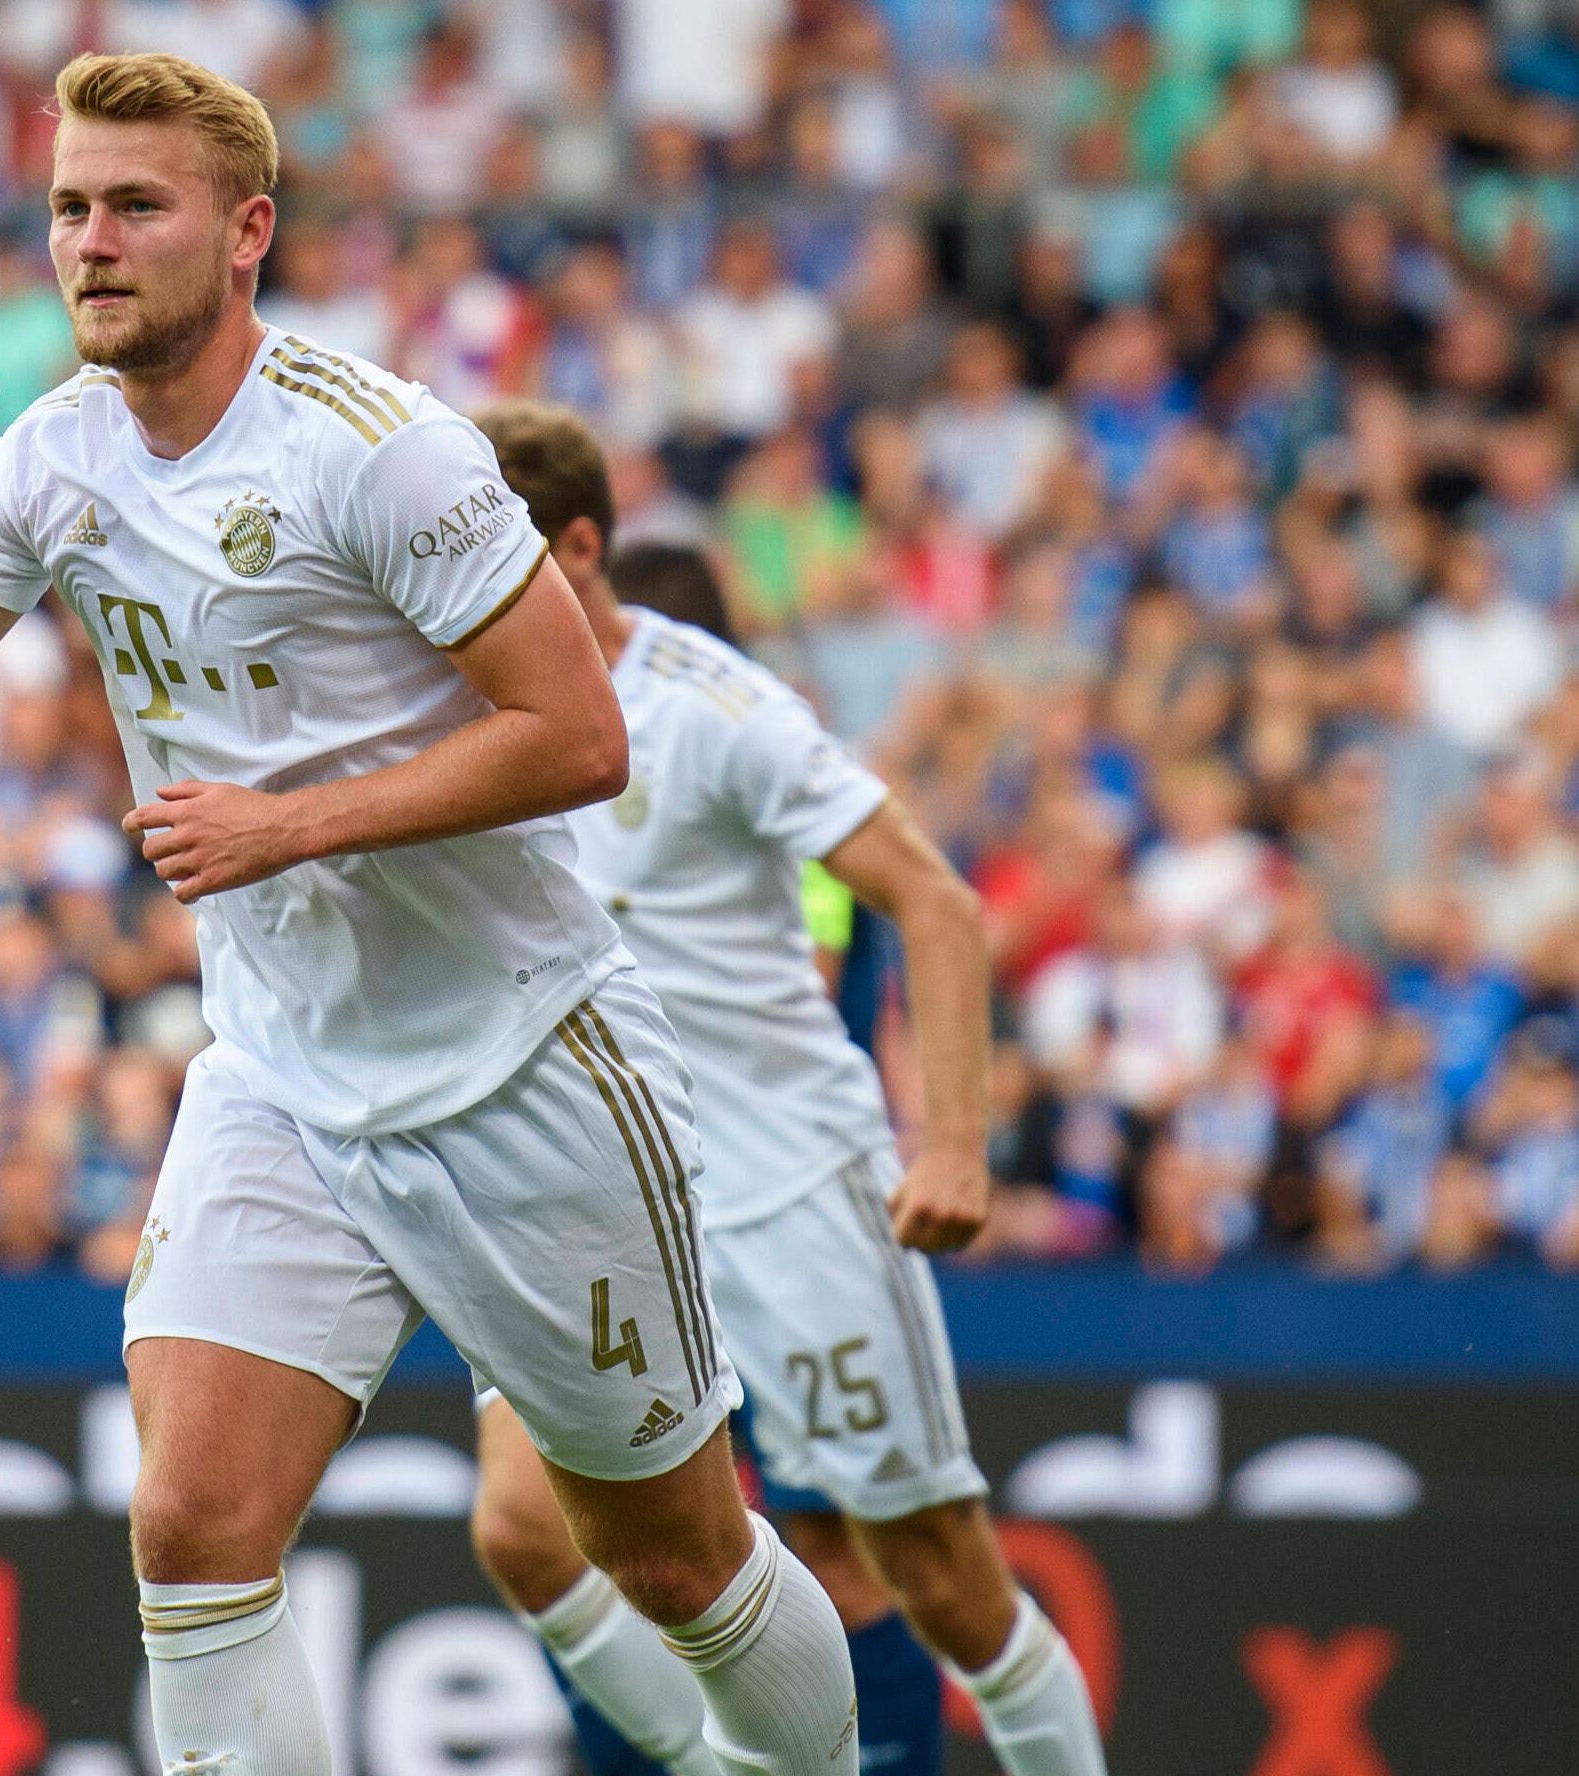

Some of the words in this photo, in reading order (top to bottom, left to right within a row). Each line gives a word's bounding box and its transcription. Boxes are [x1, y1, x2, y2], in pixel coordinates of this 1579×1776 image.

[63, 529, 108, 547] adidas
[409, 484, 503, 558] QATAR
[448, 507, 514, 561] AIRWAYS
[591, 1277, 648, 1378] 4
[786, 1336, 889, 1438] 25
[630, 1412, 684, 1447] adidas
